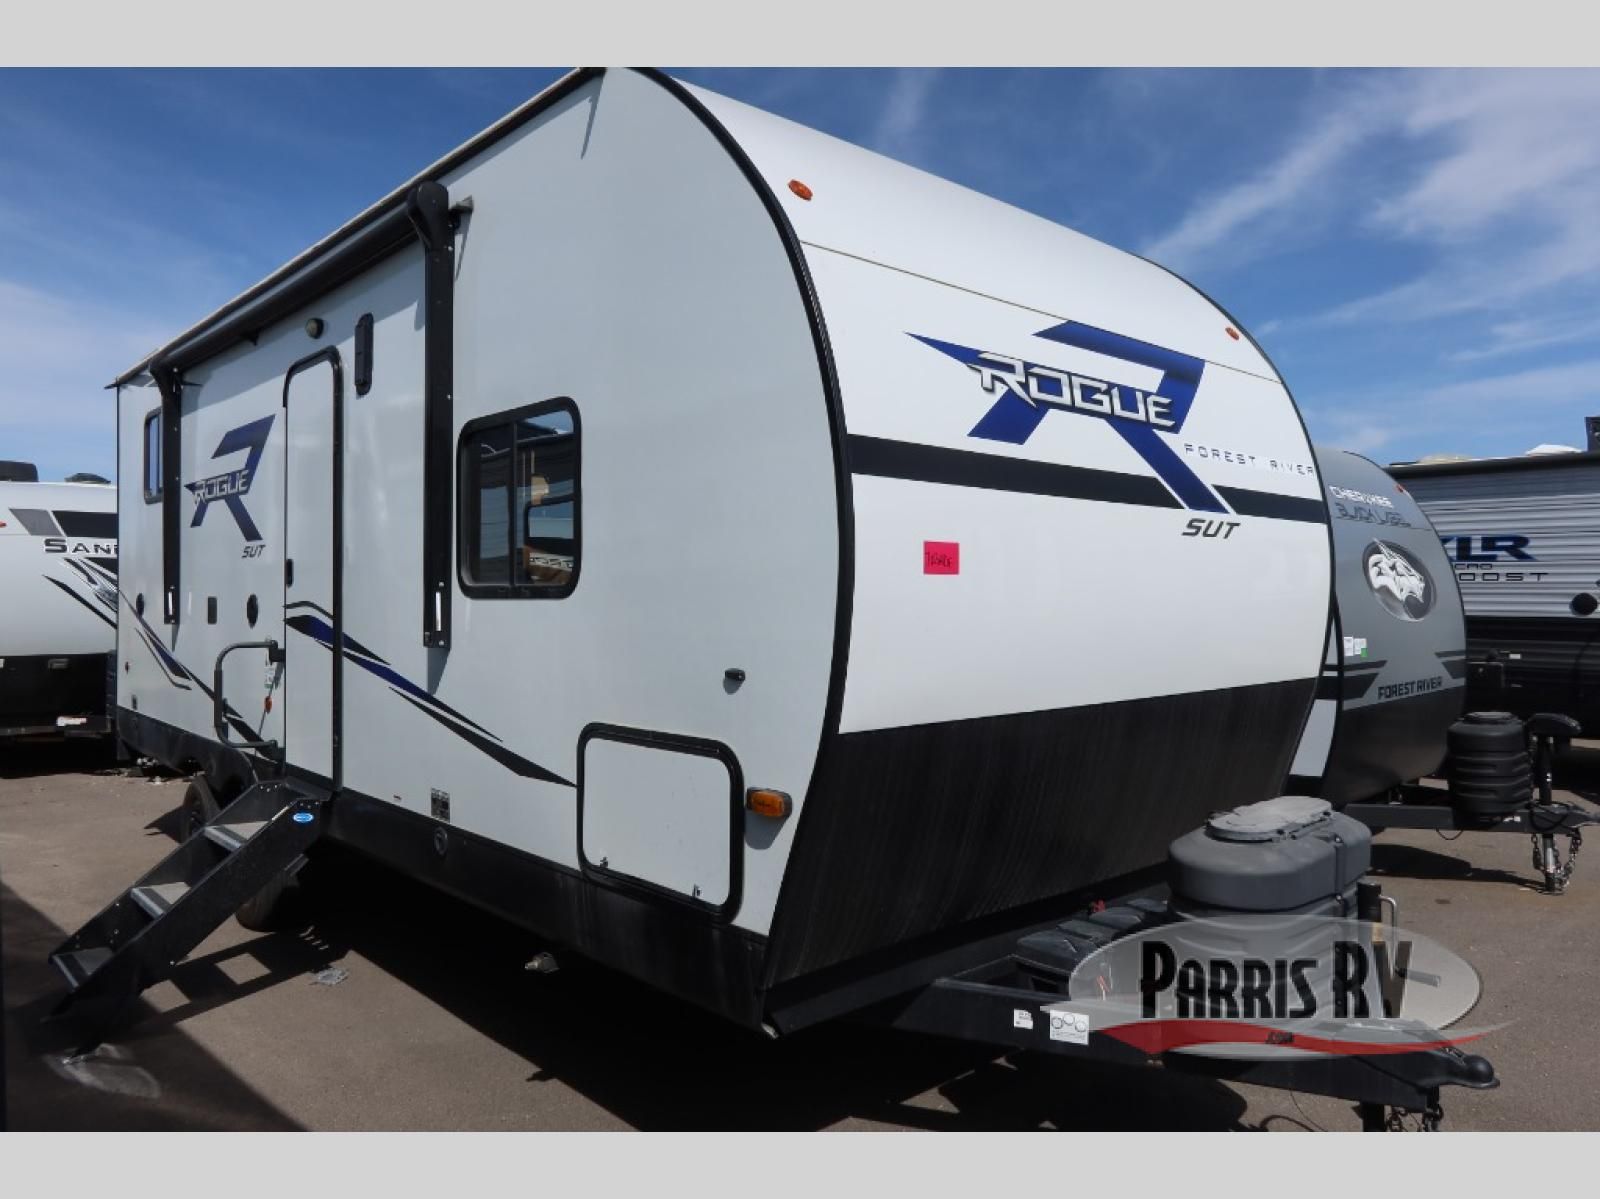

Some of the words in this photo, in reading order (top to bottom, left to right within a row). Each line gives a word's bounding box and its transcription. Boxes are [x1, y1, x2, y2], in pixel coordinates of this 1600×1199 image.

[967, 352, 1176, 428] ROGUE
[1184, 443, 1256, 465] FOREST
[1270, 460, 1315, 477] RIVER
[193, 469, 249, 506] ROGUE
[1181, 518, 1241, 539] SUT
[44, 538, 118, 555] SAN
[241, 544, 266, 559] SUT
[1459, 572, 1549, 582] OOST
[1377, 681, 1416, 700] FOREST
[1416, 676, 1443, 693] RIVER
